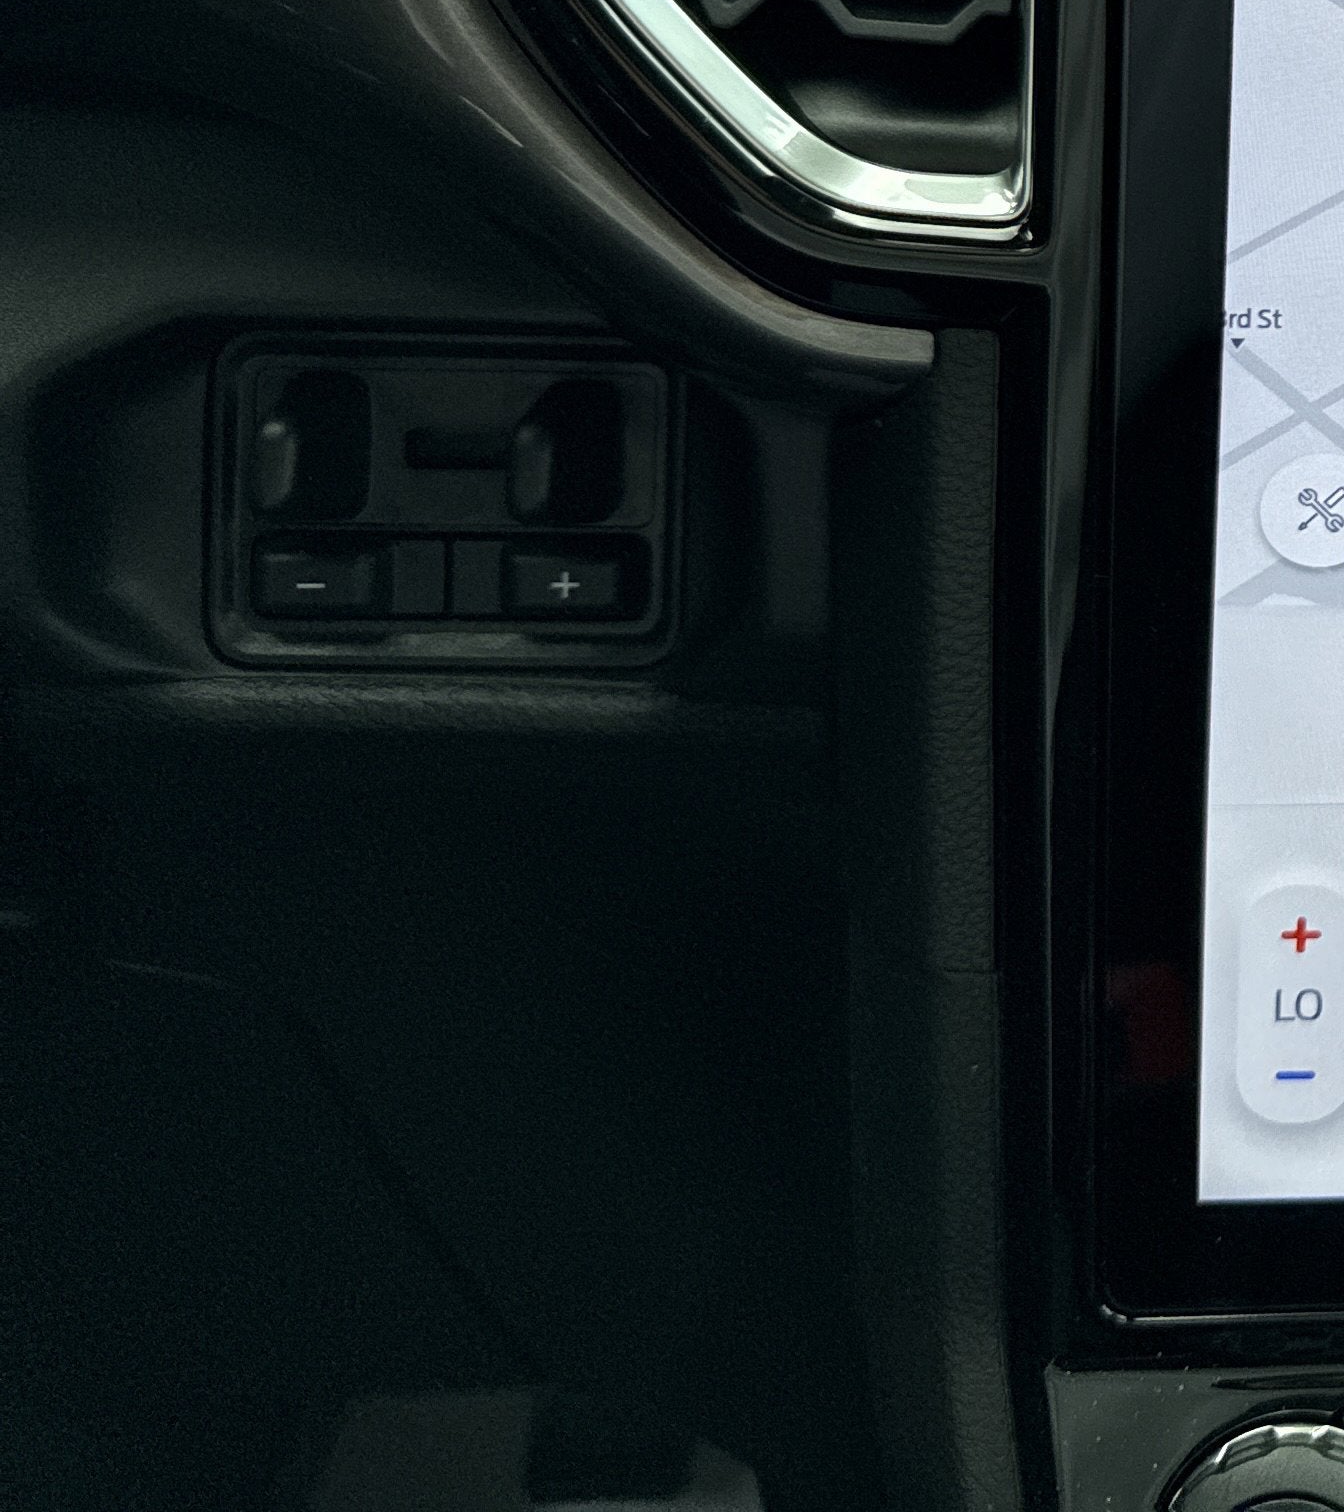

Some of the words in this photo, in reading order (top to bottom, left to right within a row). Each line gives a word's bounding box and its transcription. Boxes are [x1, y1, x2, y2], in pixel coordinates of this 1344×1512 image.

[1224, 307, 1252, 329] rd
[1257, 308, 1283, 329] St
[1274, 988, 1323, 1023] LO
